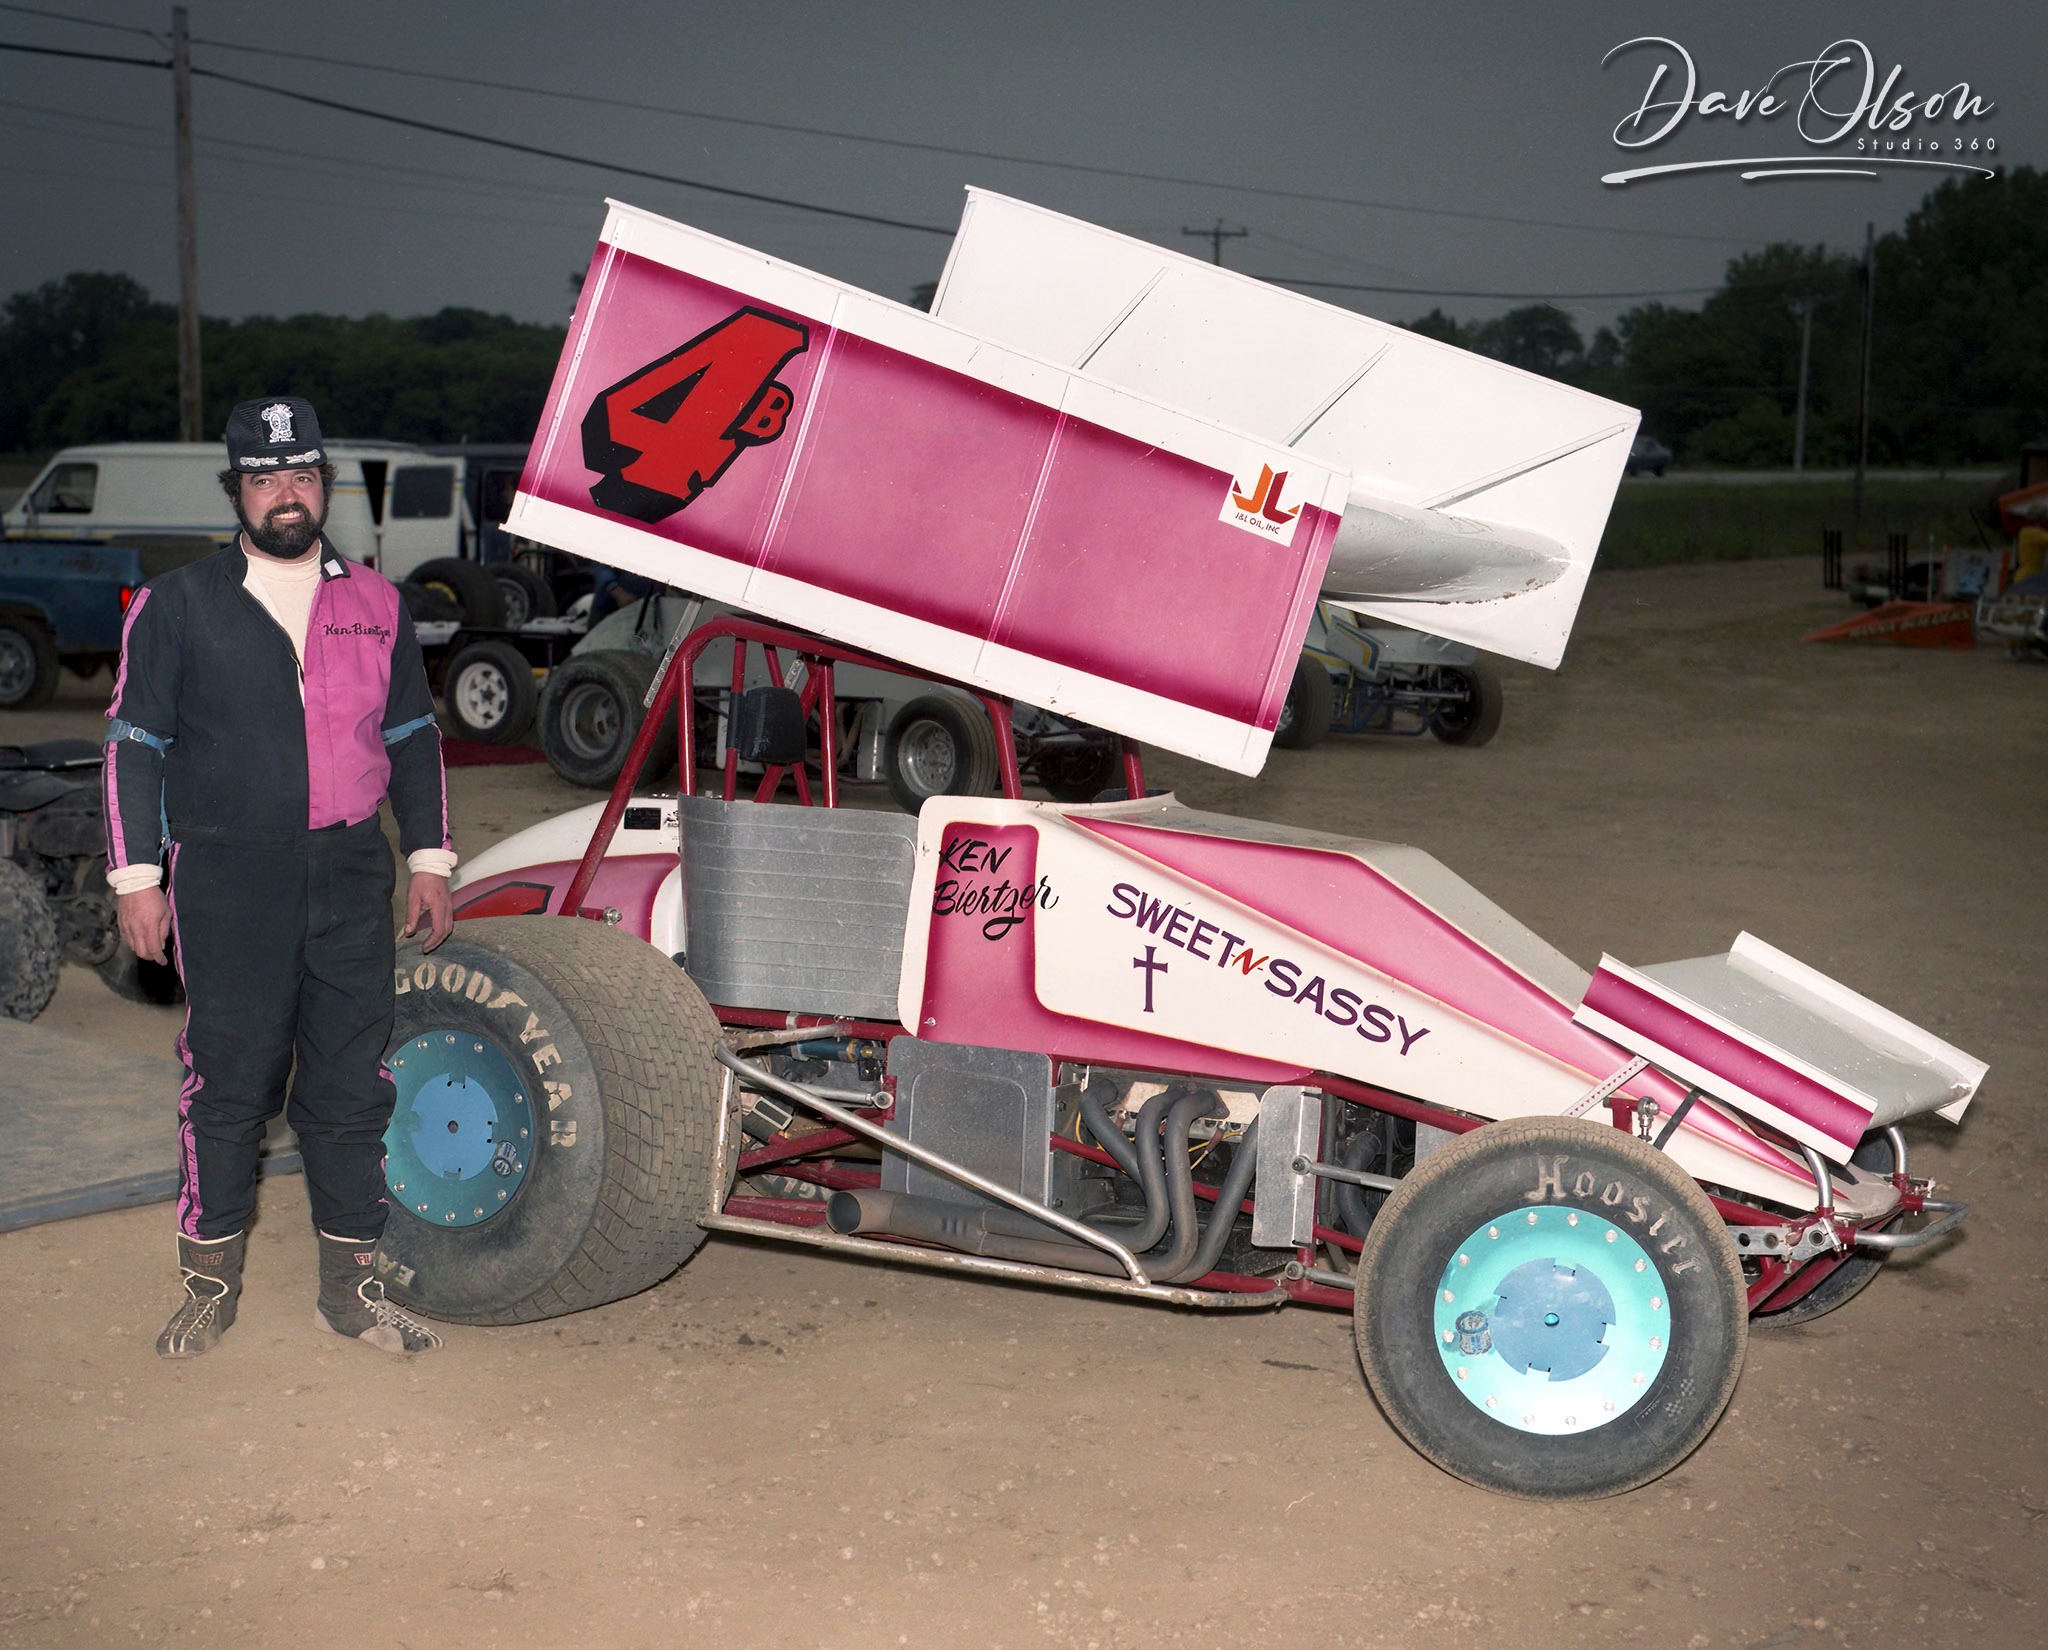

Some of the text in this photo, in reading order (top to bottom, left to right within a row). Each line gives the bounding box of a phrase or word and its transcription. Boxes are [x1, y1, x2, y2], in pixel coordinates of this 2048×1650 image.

[1235, 512, 1248, 523] J&L
[323, 623, 351, 635] Ken
[938, 837, 1013, 874] KEN
[932, 875, 1060, 941] Biertzer
[1106, 883, 1246, 968] SWEET
[1264, 958, 1431, 1056] SASSY
[393, 963, 577, 1148] GOODYEAR
